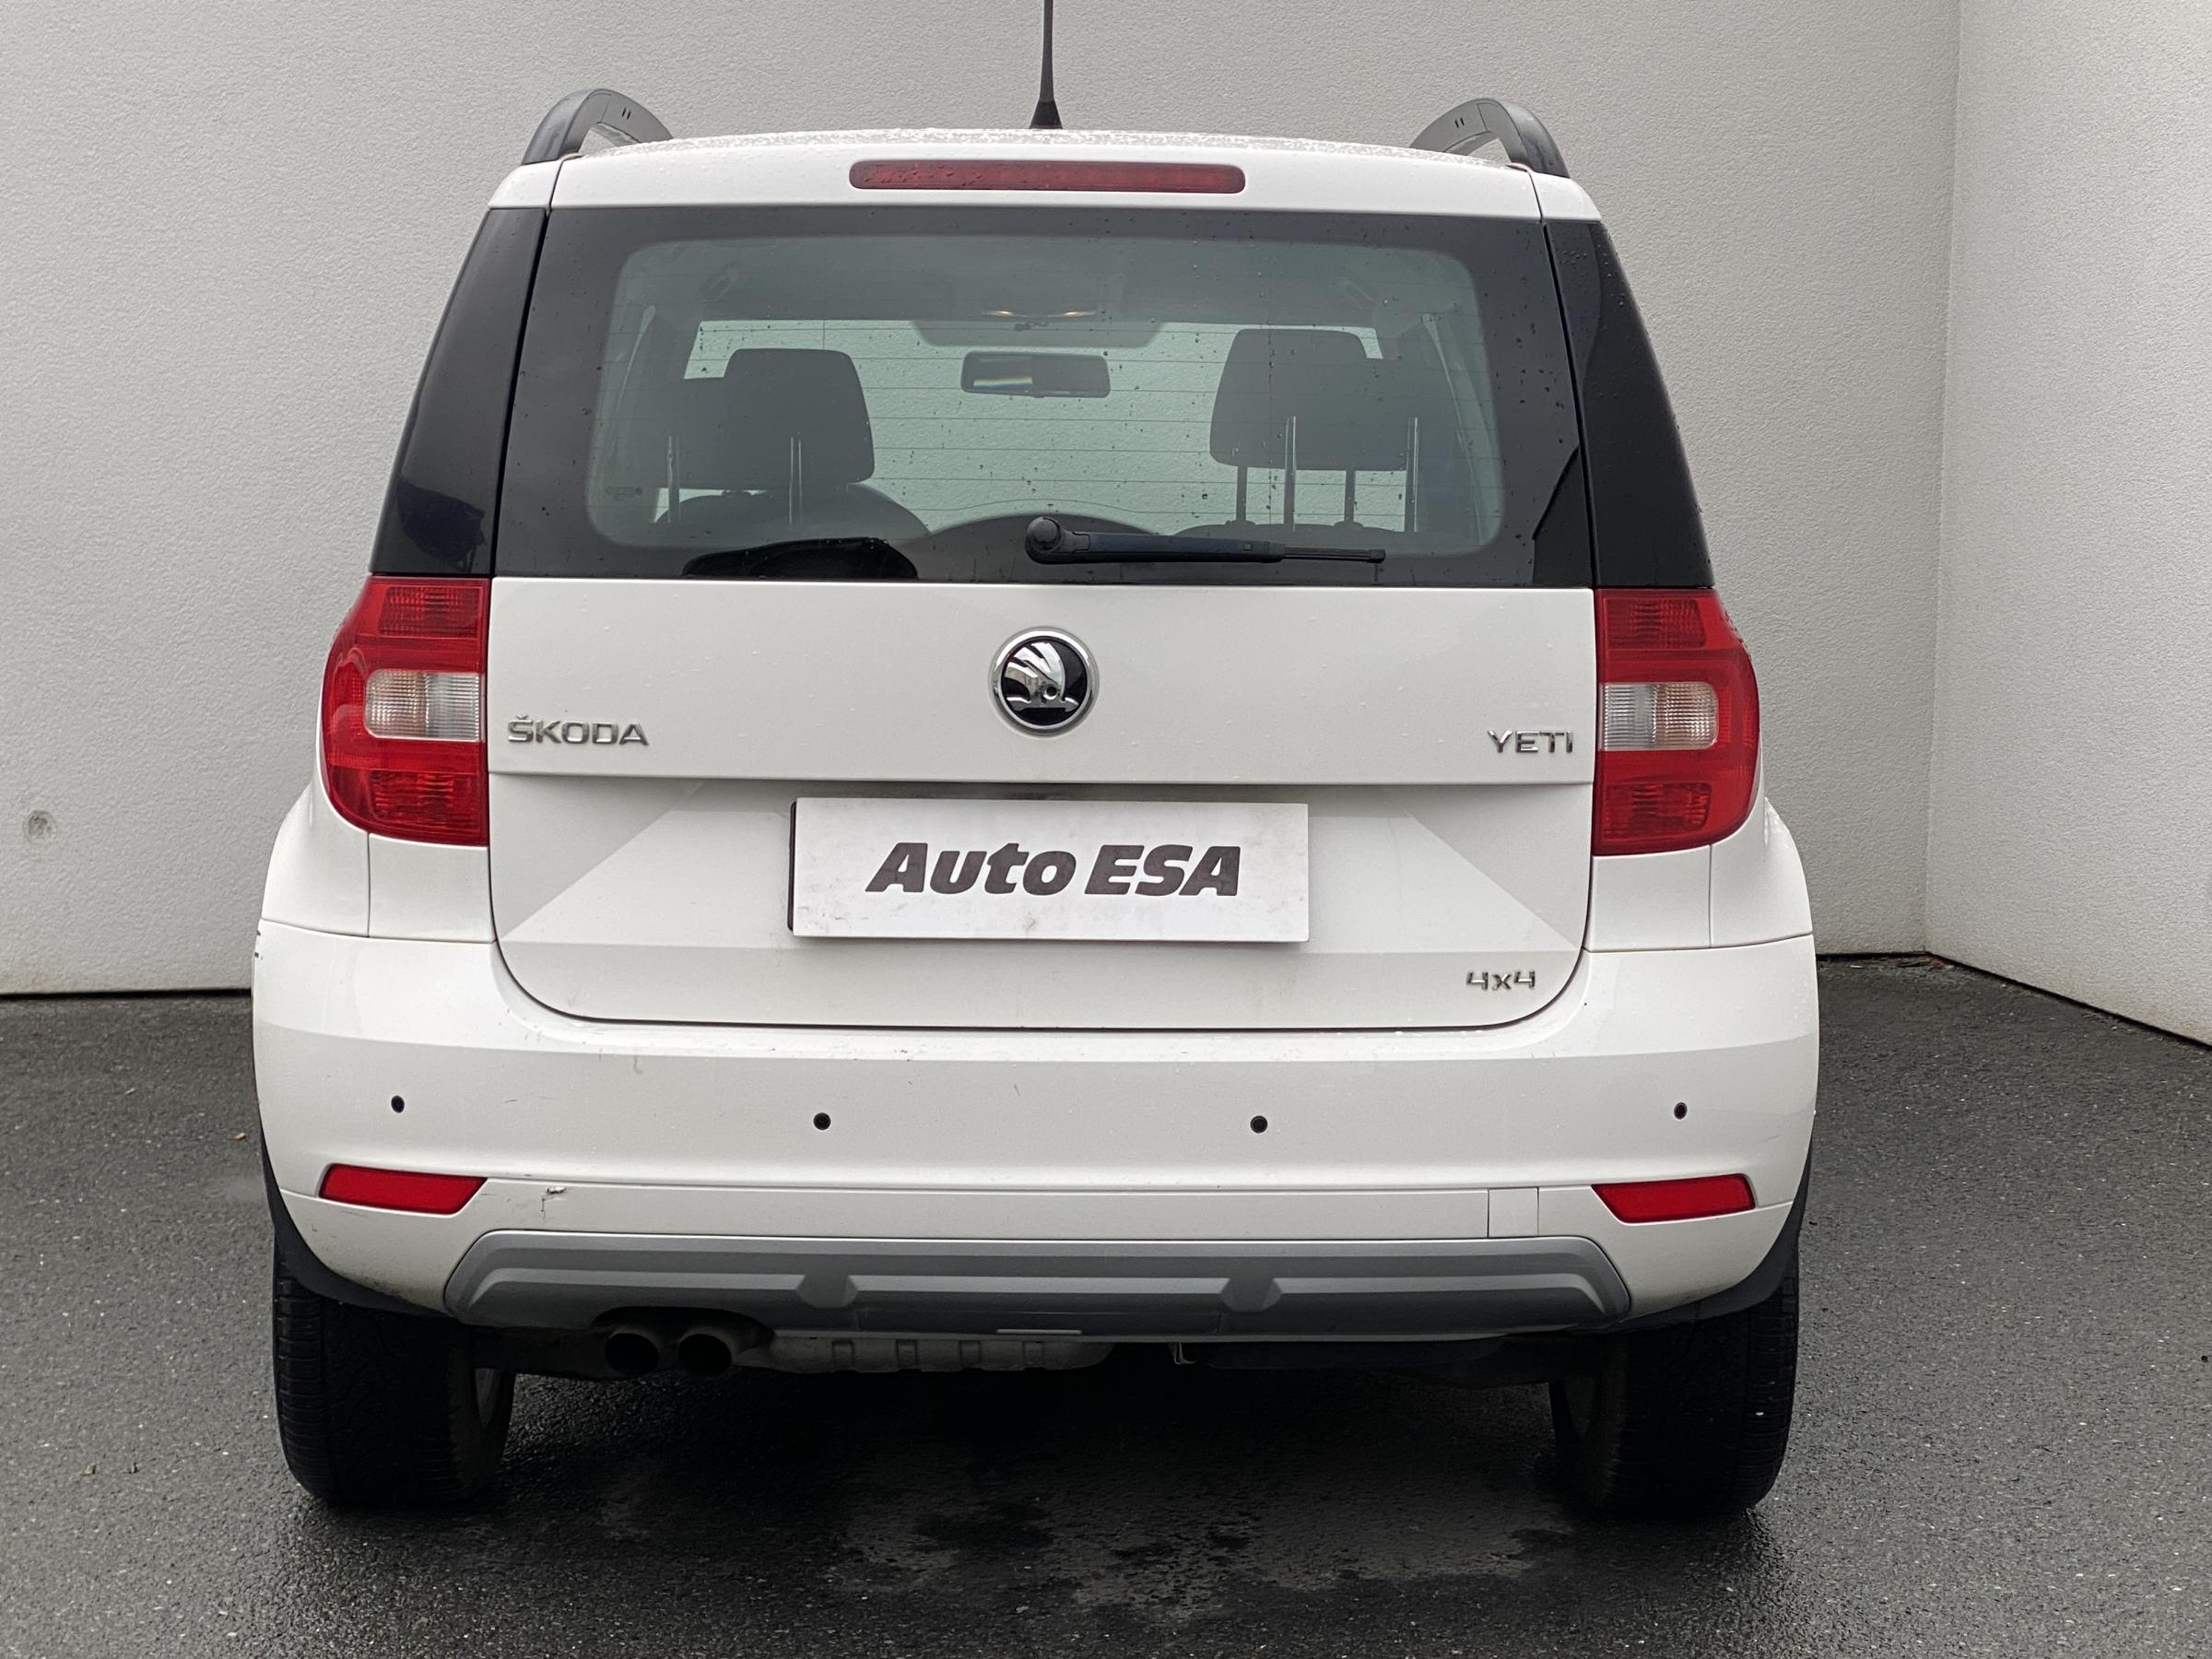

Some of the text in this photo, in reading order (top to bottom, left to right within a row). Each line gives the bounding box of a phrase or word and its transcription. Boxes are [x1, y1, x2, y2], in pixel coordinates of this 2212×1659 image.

[508, 714, 649, 746] ŠKODA
[1487, 730, 1573, 754] YETI
[865, 841, 1241, 896] Auto ESA
[1466, 971, 1535, 991] 4x4
